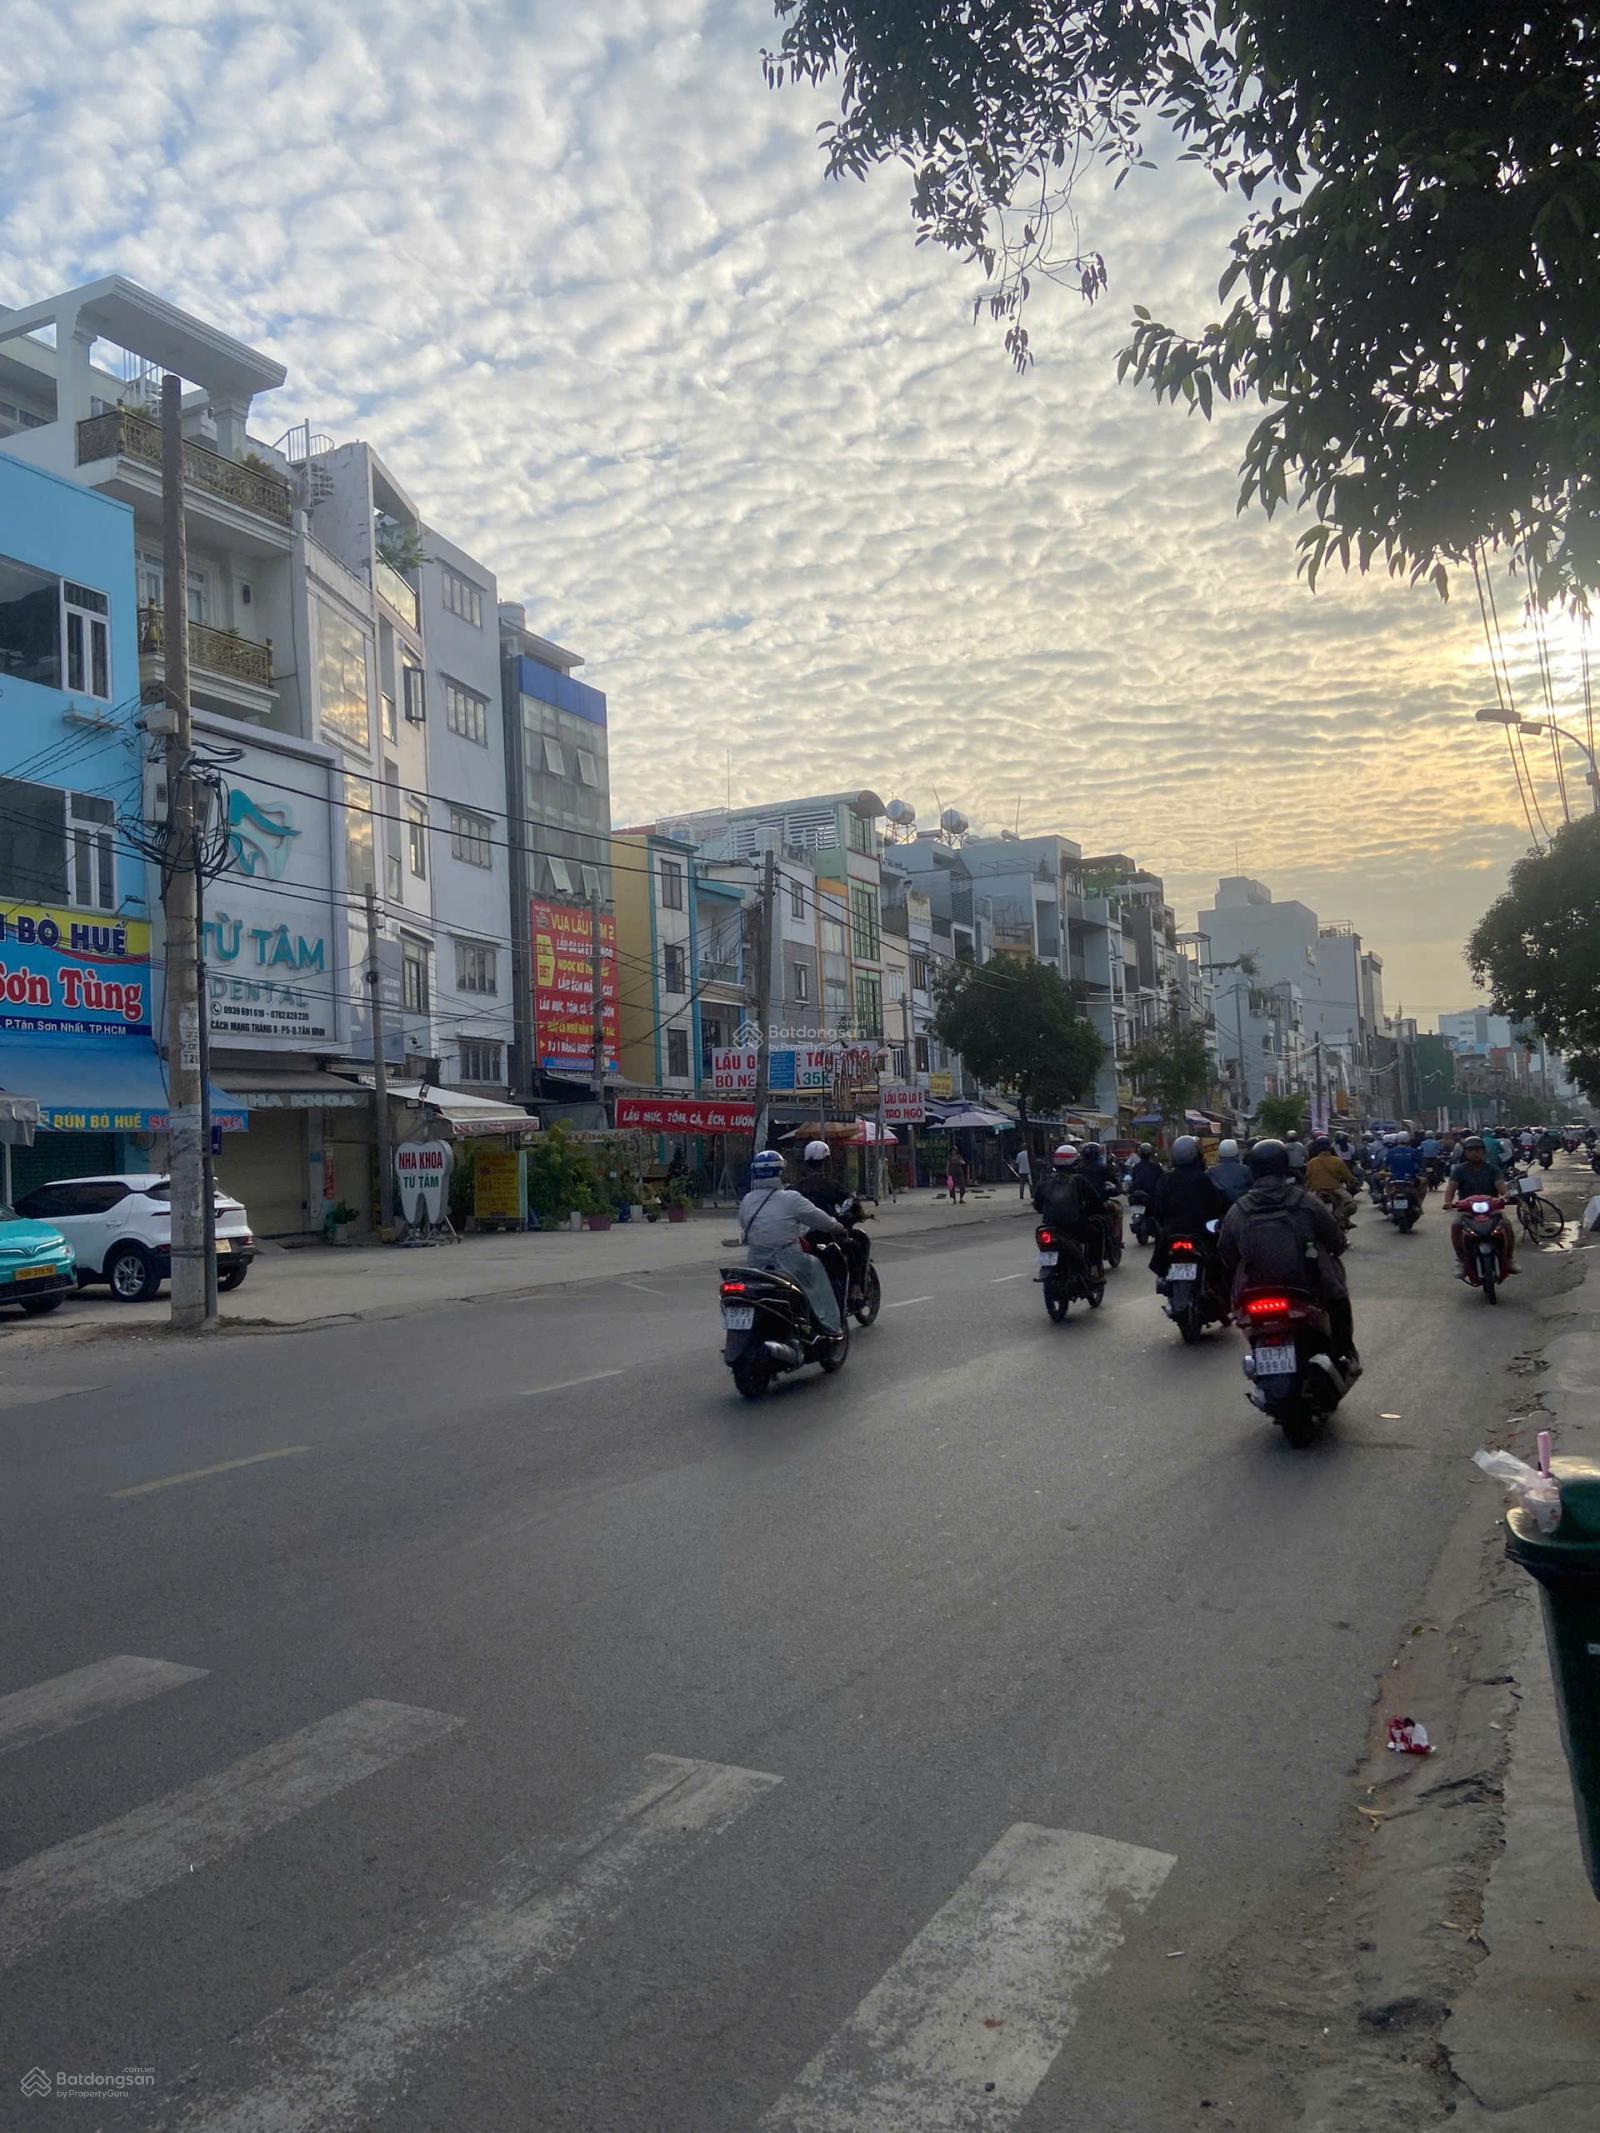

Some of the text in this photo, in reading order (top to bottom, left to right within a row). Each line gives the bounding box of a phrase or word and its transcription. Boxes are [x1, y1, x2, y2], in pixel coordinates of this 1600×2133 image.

[17, 912, 60, 947] BÒ
[70, 920, 128, 955] HUẾ
[248, 923, 324, 972] TÂM
[59, 967, 142, 1022] Tùng
[208, 980, 309, 1007] DENTAL
[37, 1020, 58, 1032] Sơn
[89, 1024, 126, 1035] TP.HCM
[715, 1049, 741, 1071] LẨU
[715, 1072, 733, 1088] BÒ
[290, 1094, 357, 1108] KHOA
[54, 1113, 85, 1130] BÚN
[114, 1113, 142, 1130] HUẾ
[399, 1151, 443, 1169] NHA KHOA
[418, 1172, 439, 1188] TÂM
